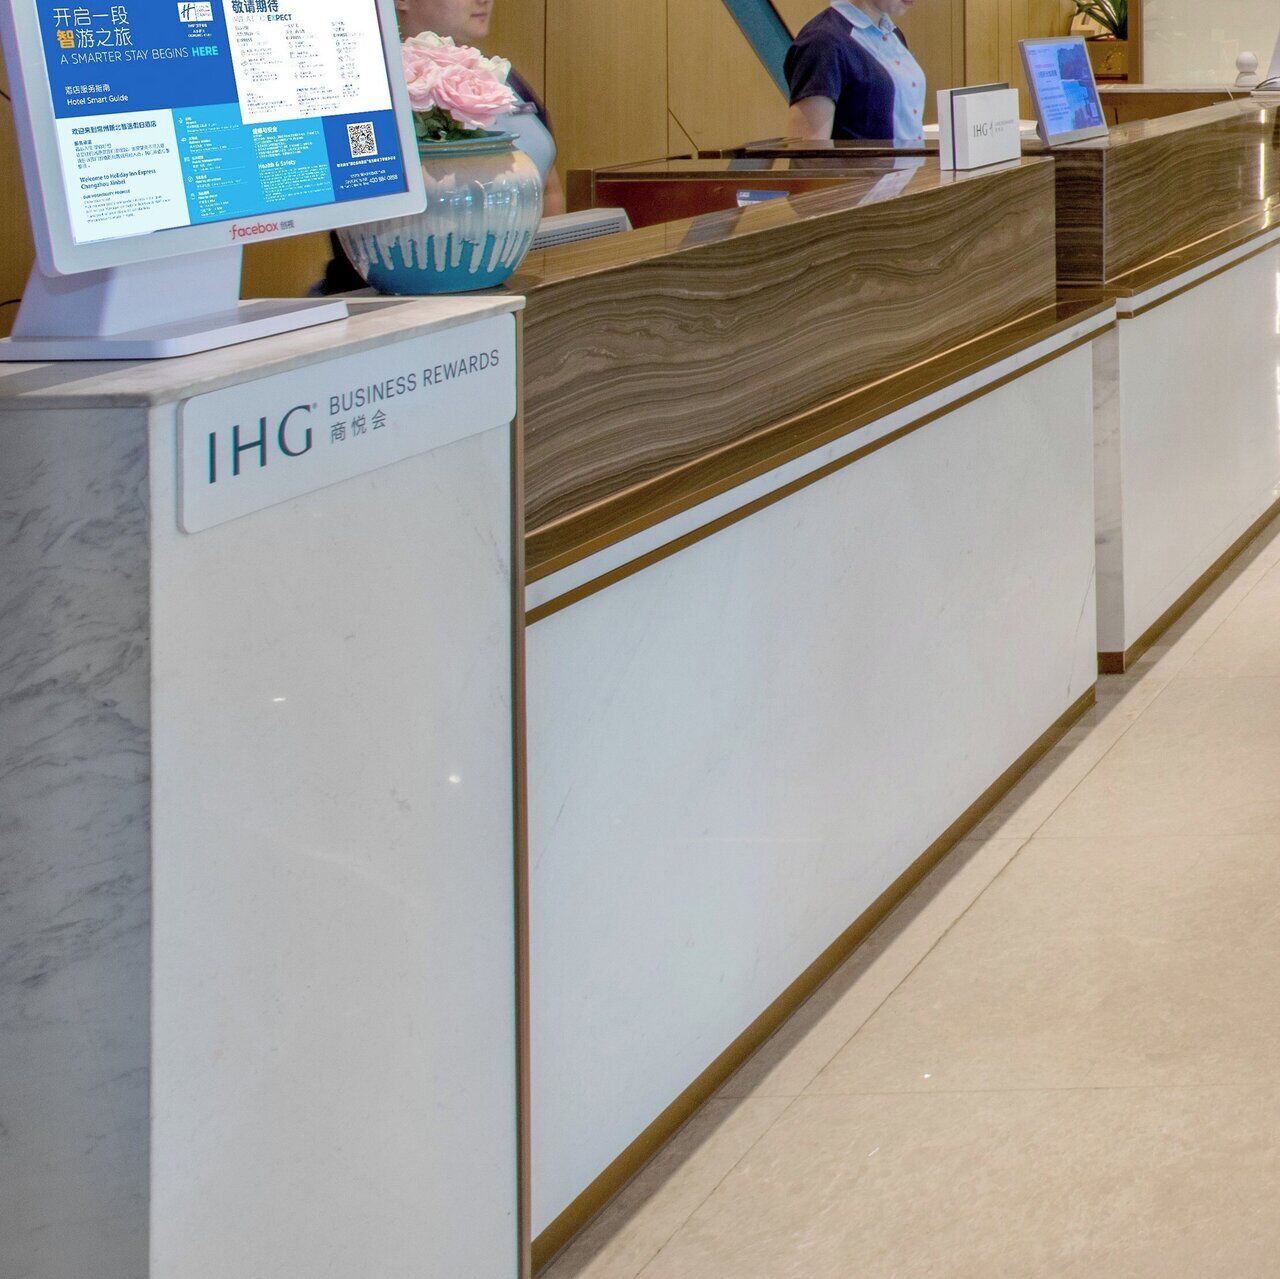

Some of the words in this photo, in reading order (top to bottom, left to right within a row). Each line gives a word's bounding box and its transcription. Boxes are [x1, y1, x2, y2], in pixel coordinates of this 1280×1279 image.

[53, 5, 130, 27] 开启一段
[267, 13, 292, 22] EXPECT
[56, 27, 134, 49] 智游之旅
[60, 54, 69, 65] A
[72, 51, 123, 65] SMARTER
[126, 49, 148, 61] STAY
[152, 47, 189, 59] BEGINS
[191, 45, 219, 57] HERE
[67, 97, 86, 106] Hotel
[87, 95, 108, 104] Smart
[108, 94, 129, 103] Guide
[973, 122, 988, 138] IHG
[231, 222, 279, 240] facebox
[208, 404, 313, 484] IHG
[329, 372, 418, 416] BUSINESS
[422, 349, 500, 388] REWARDS
[329, 409, 388, 445] 商悦会
